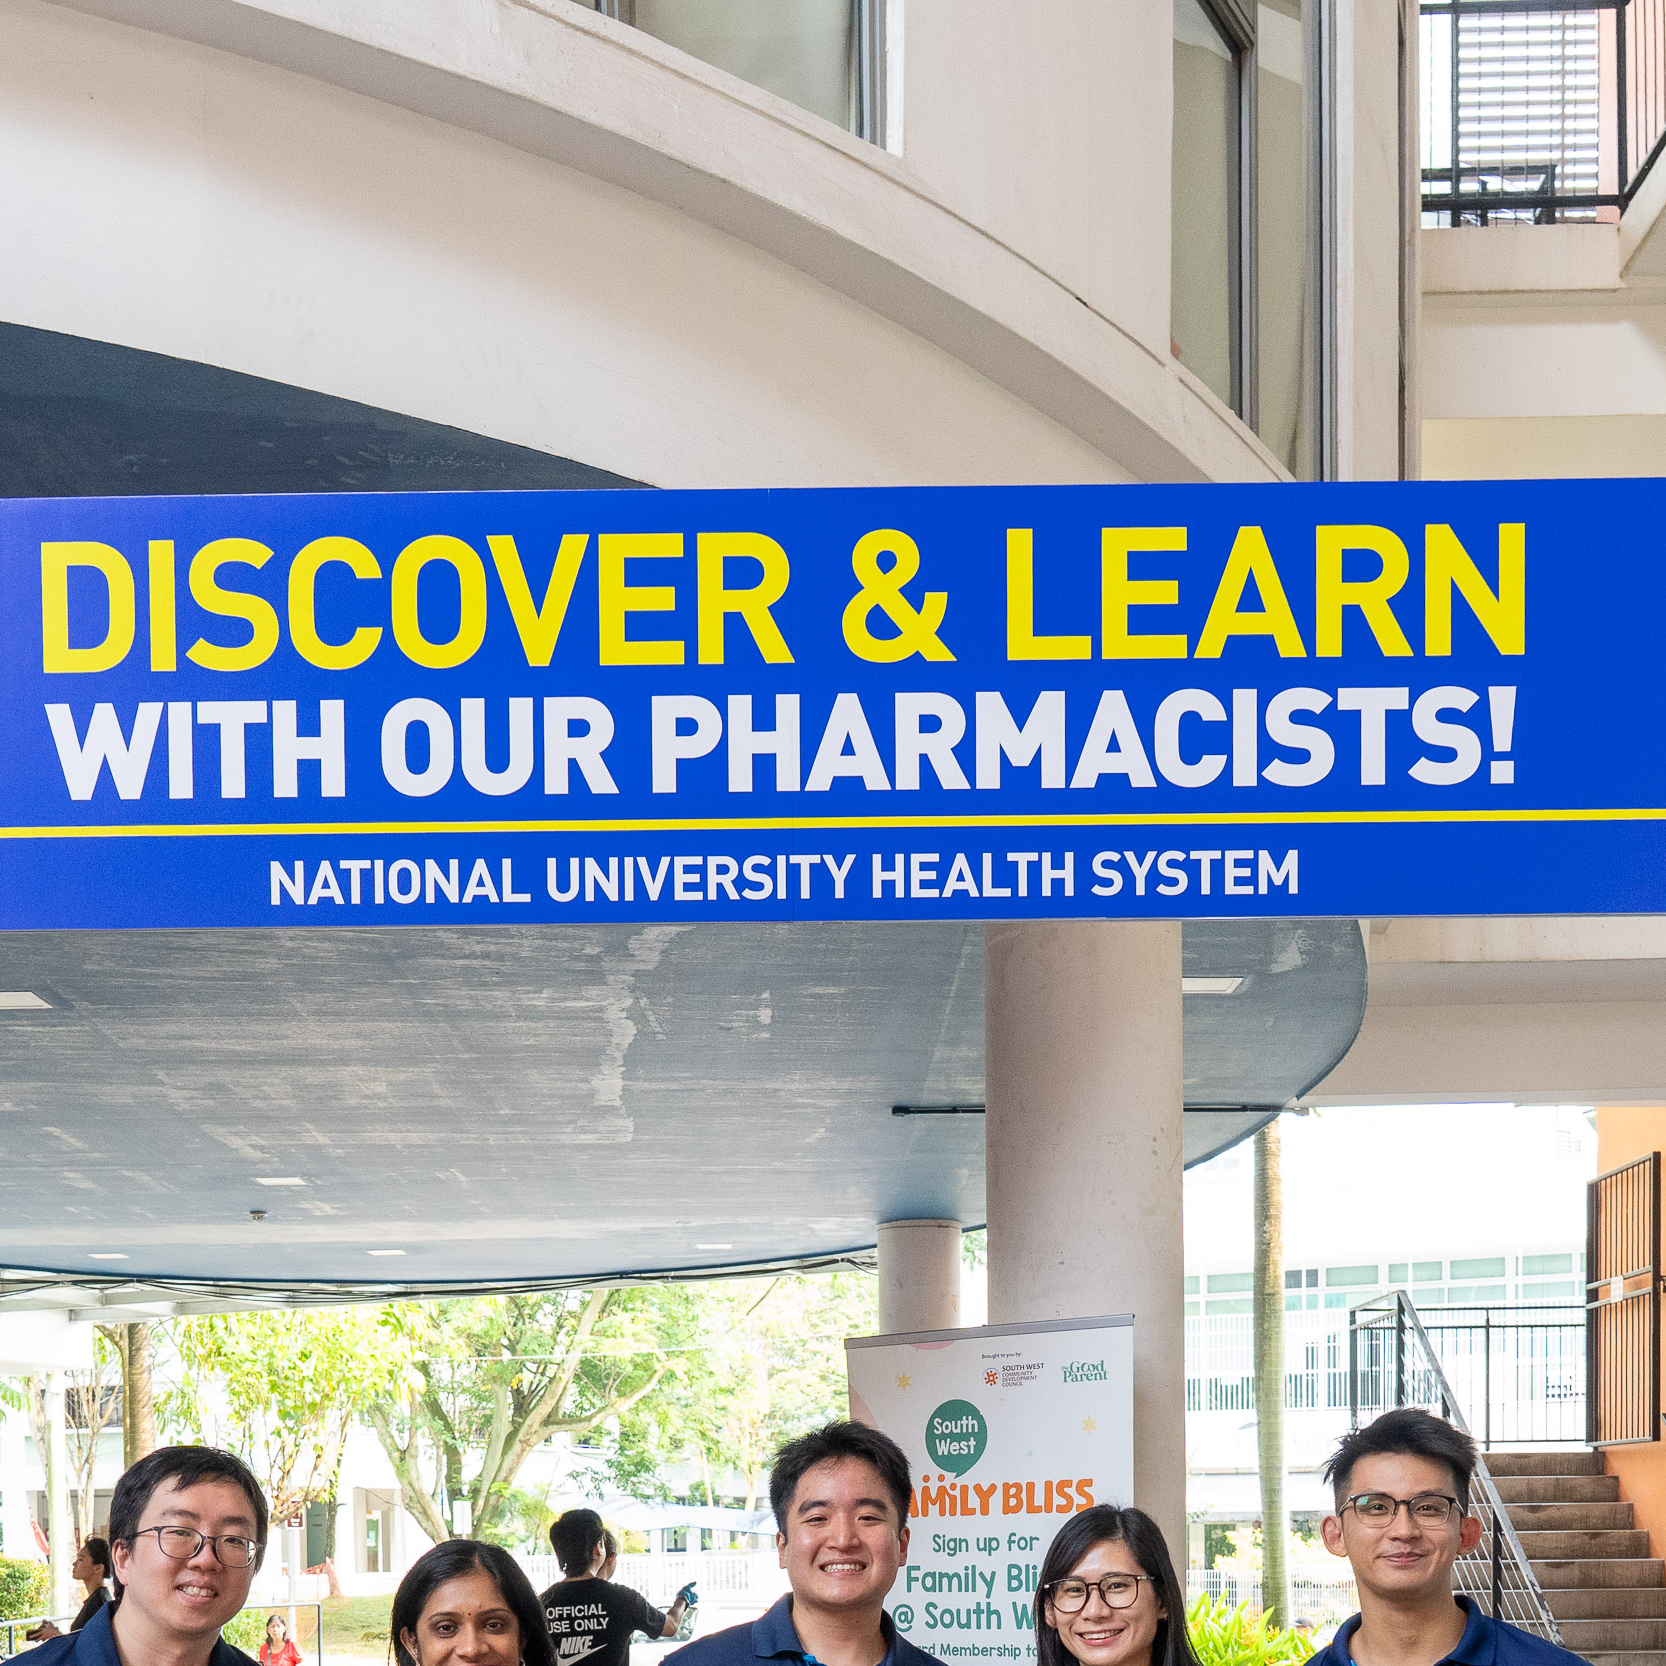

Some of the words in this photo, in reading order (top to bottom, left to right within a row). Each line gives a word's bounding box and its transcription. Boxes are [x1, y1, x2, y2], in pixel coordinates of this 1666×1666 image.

[39, 533, 794, 675] DISCOVER
[841, 529, 956, 663] &
[1006, 522, 1527, 662] LEARN
[46, 699, 346, 803] WITH
[380, 696, 620, 796] OUR
[651, 686, 1520, 796] PHARMACISTS!
[268, 860, 531, 908] NATIONAL
[544, 854, 856, 905] UNIVERSITY
[872, 850, 1077, 900] HEALTH
[1091, 848, 1300, 897] SYSTEM
[1002, 1364, 1024, 1372] SOUTH
[1070, 1360, 1104, 1373] Good
[1063, 1371, 1108, 1382] Parent
[933, 1416, 978, 1435] South
[935, 1437, 976, 1456] West
[1003, 1479, 1094, 1515] BLISS
[933, 1534, 969, 1556] Sign
[976, 1536, 1000, 1556] up
[1007, 1532, 1039, 1551] for
[907, 1565, 995, 1598] Family
[546, 1604, 606, 1619] OFFICIAL
[893, 1604, 915, 1632] @
[925, 1602, 1001, 1630] South
[547, 1621, 570, 1633] USE
[574, 1617, 609, 1631] ONLY
[560, 1636, 593, 1654] NIKE
[940, 1643, 1021, 1658] Membership
